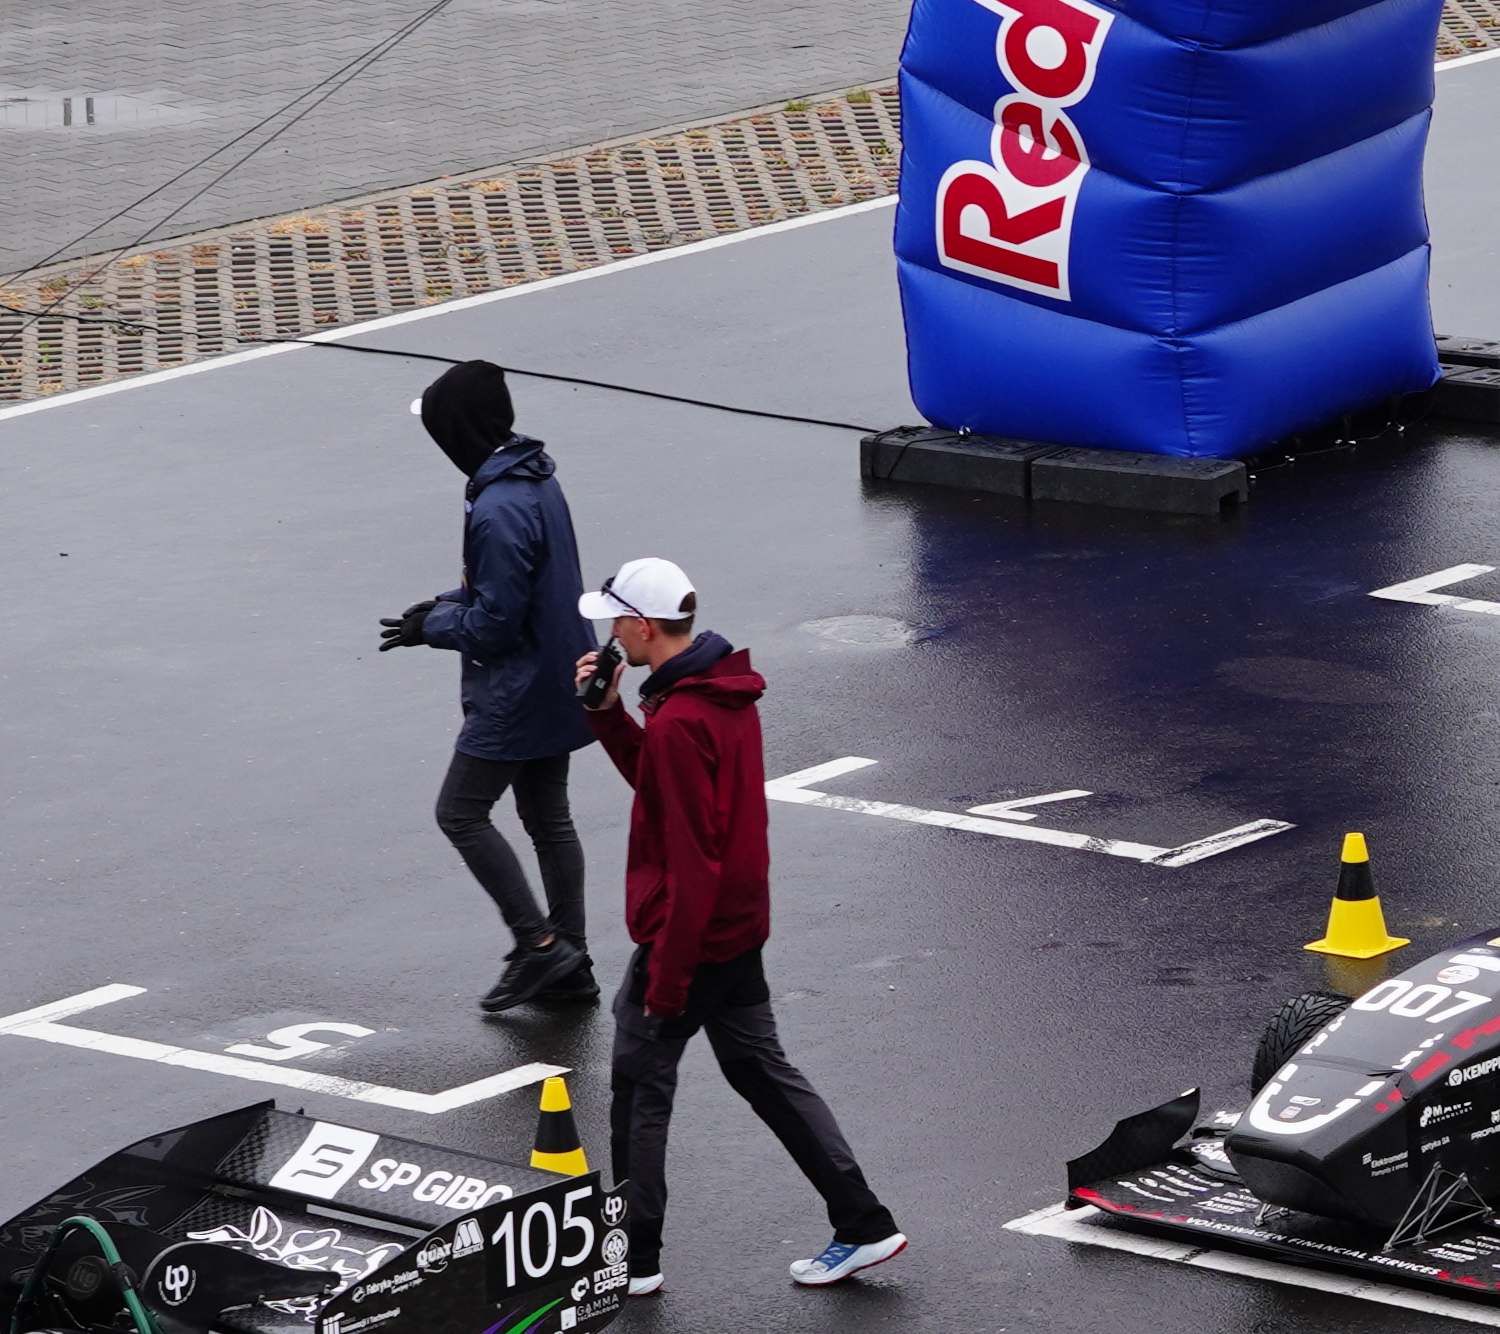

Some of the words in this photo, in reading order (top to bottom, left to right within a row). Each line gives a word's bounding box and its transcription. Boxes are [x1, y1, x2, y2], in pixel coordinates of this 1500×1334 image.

[1351, 979, 1492, 1023] 007
[224, 1021, 376, 1060] 5
[358, 1158, 421, 1192] SP
[492, 1186, 594, 1288] 105
[1186, 1217, 1286, 1243] VOLKSWAGEN
[1287, 1237, 1367, 1260] FINANCIAL
[1367, 1255, 1441, 1276] SERVICES
[593, 1261, 628, 1282] INTER
[594, 1274, 628, 1295] CARS
[577, 1293, 620, 1317] GAMMA
